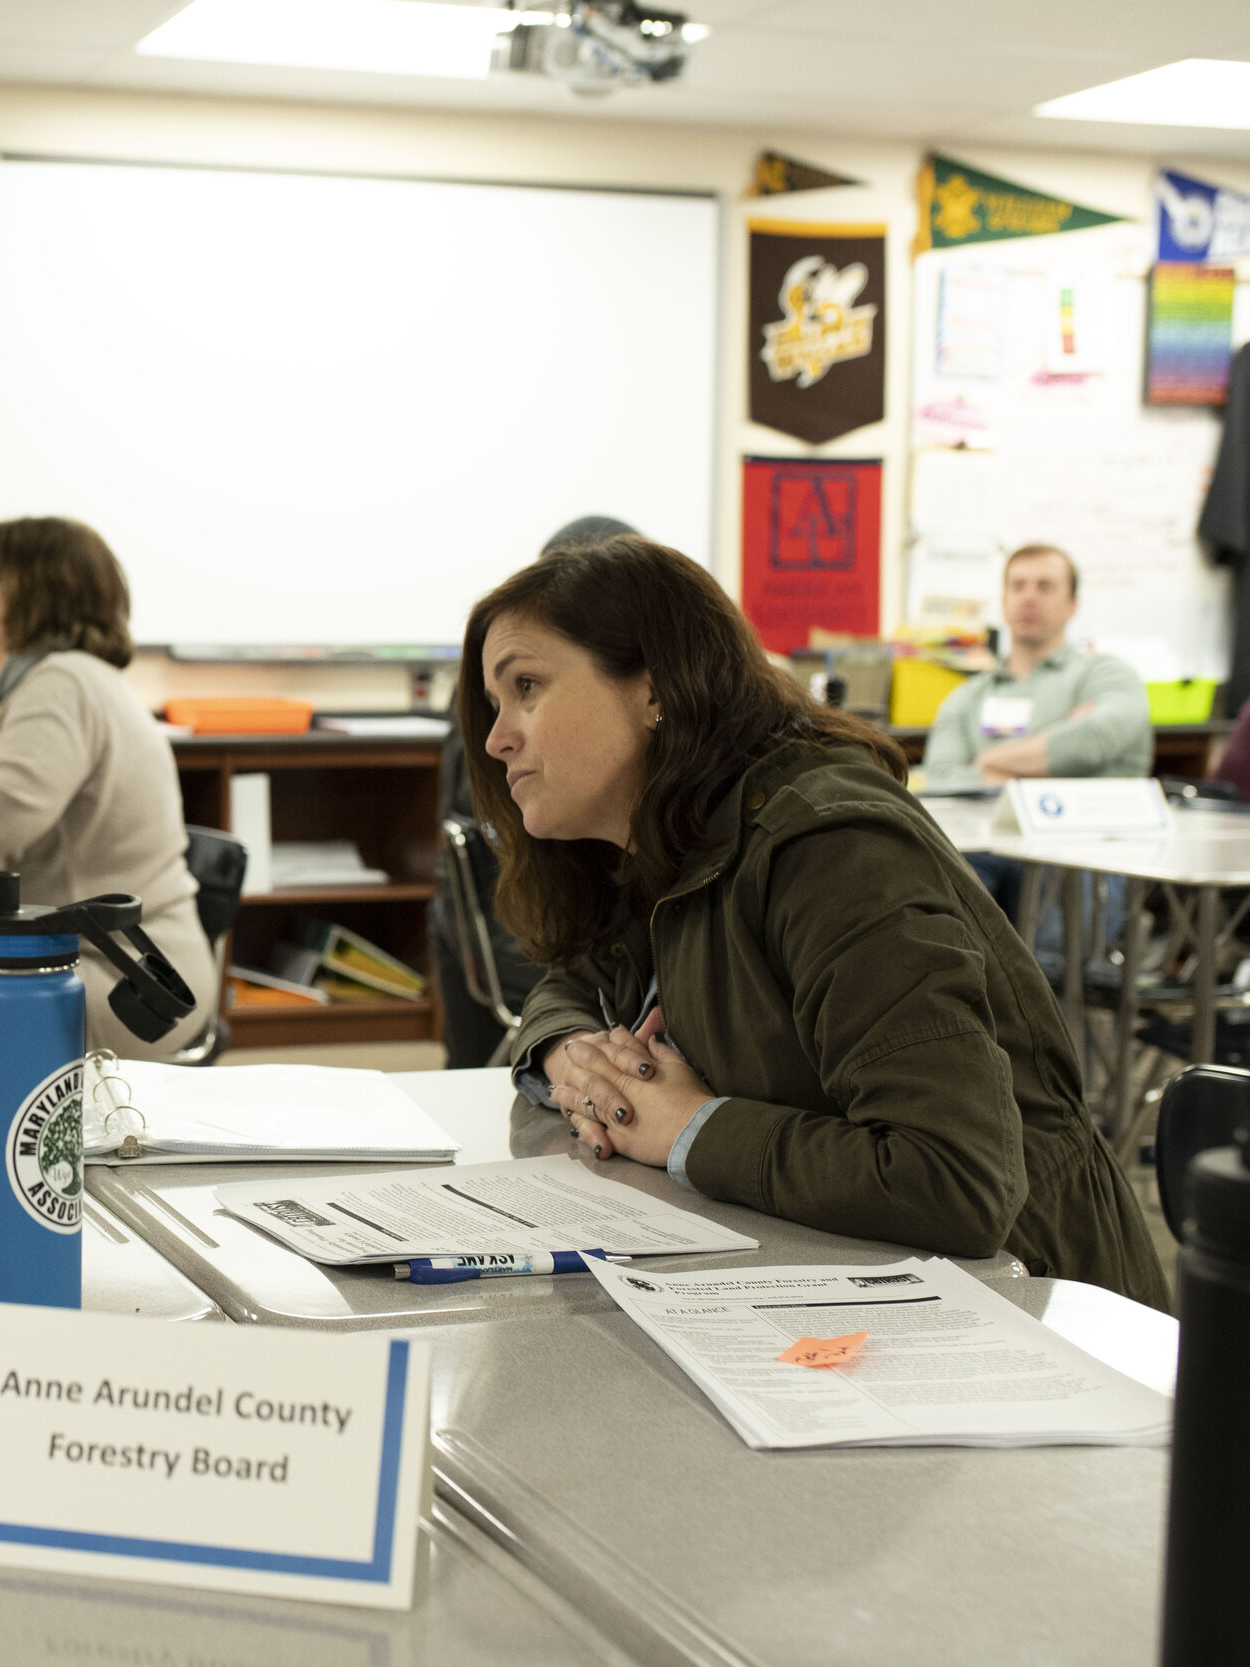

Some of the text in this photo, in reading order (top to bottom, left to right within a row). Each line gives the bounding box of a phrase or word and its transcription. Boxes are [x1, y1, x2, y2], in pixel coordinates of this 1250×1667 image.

[19, 1071, 79, 1157] MARYLAND
[0, 1369, 353, 1436] Anne Arundel County
[48, 1431, 290, 1484] Forestry Board
